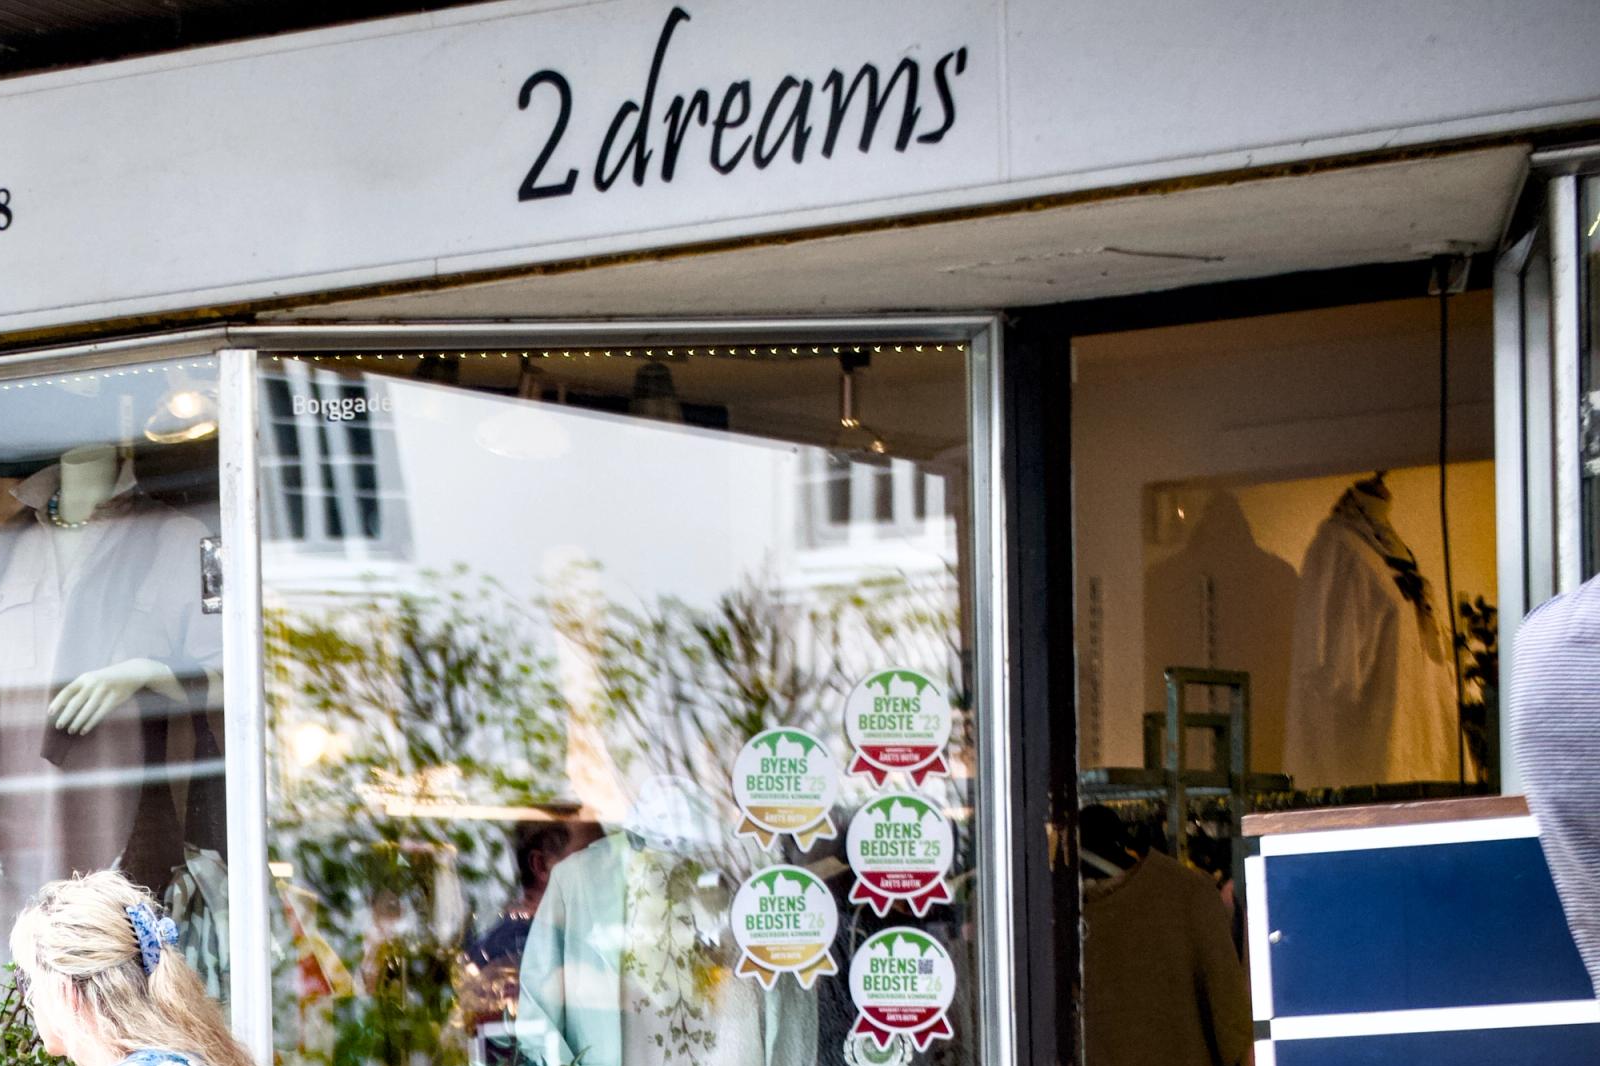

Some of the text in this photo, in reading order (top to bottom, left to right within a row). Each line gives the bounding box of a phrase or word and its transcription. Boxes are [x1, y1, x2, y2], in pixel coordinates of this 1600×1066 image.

[293, 393, 393, 420] Borggade
[873, 697, 921, 713] BYENS
[859, 715, 913, 731] BEDSTE
[761, 757, 808, 774] BYENS
[746, 775, 801, 791] BEDSTE
[875, 823, 922, 839] BYENS
[860, 840, 941, 856] BEDSTE '25
[760, 896, 806, 912] BYENS
[745, 913, 801, 930] BEDSTE
[870, 958, 917, 974] BYENS
[863, 975, 918, 991] BEDSTE
